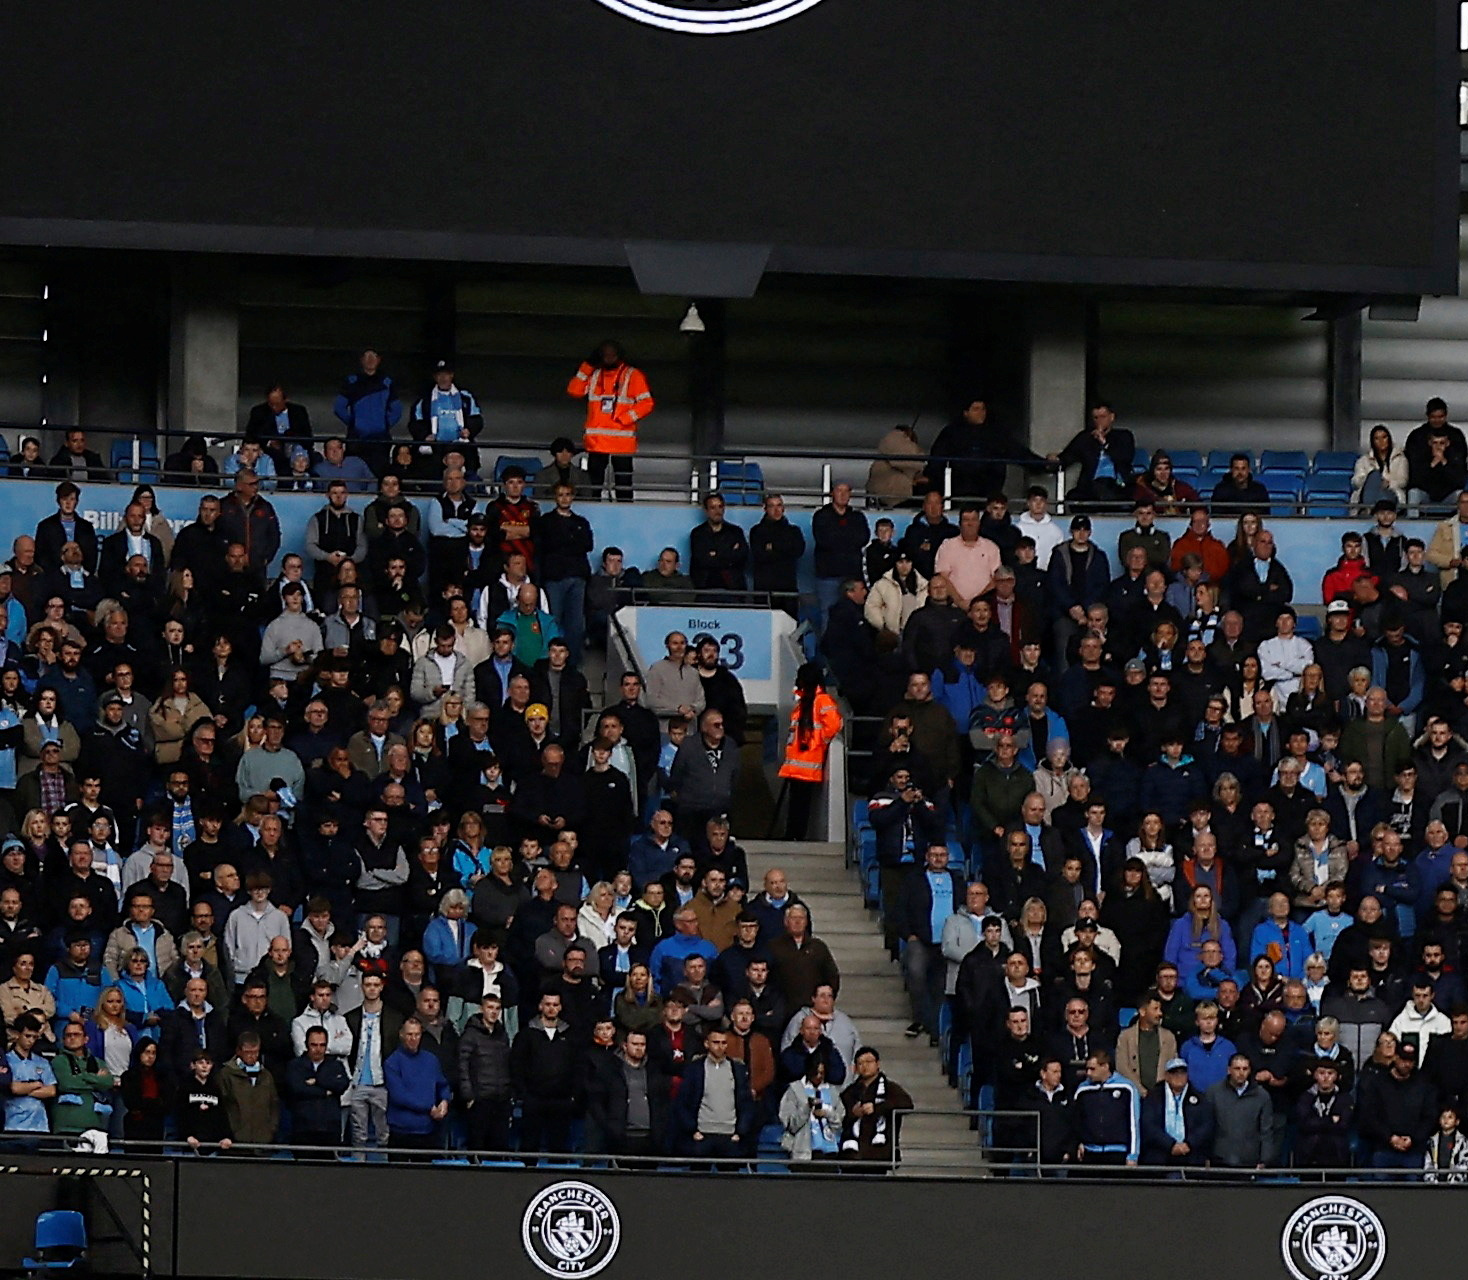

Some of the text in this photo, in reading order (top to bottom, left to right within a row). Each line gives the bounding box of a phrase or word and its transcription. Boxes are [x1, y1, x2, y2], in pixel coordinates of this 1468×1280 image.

[688, 618, 721, 630] Block
[536, 1190, 608, 1221] MANCHESTER
[1296, 1205, 1374, 1234] MANCHESTER
[557, 1260, 586, 1271] CITY
